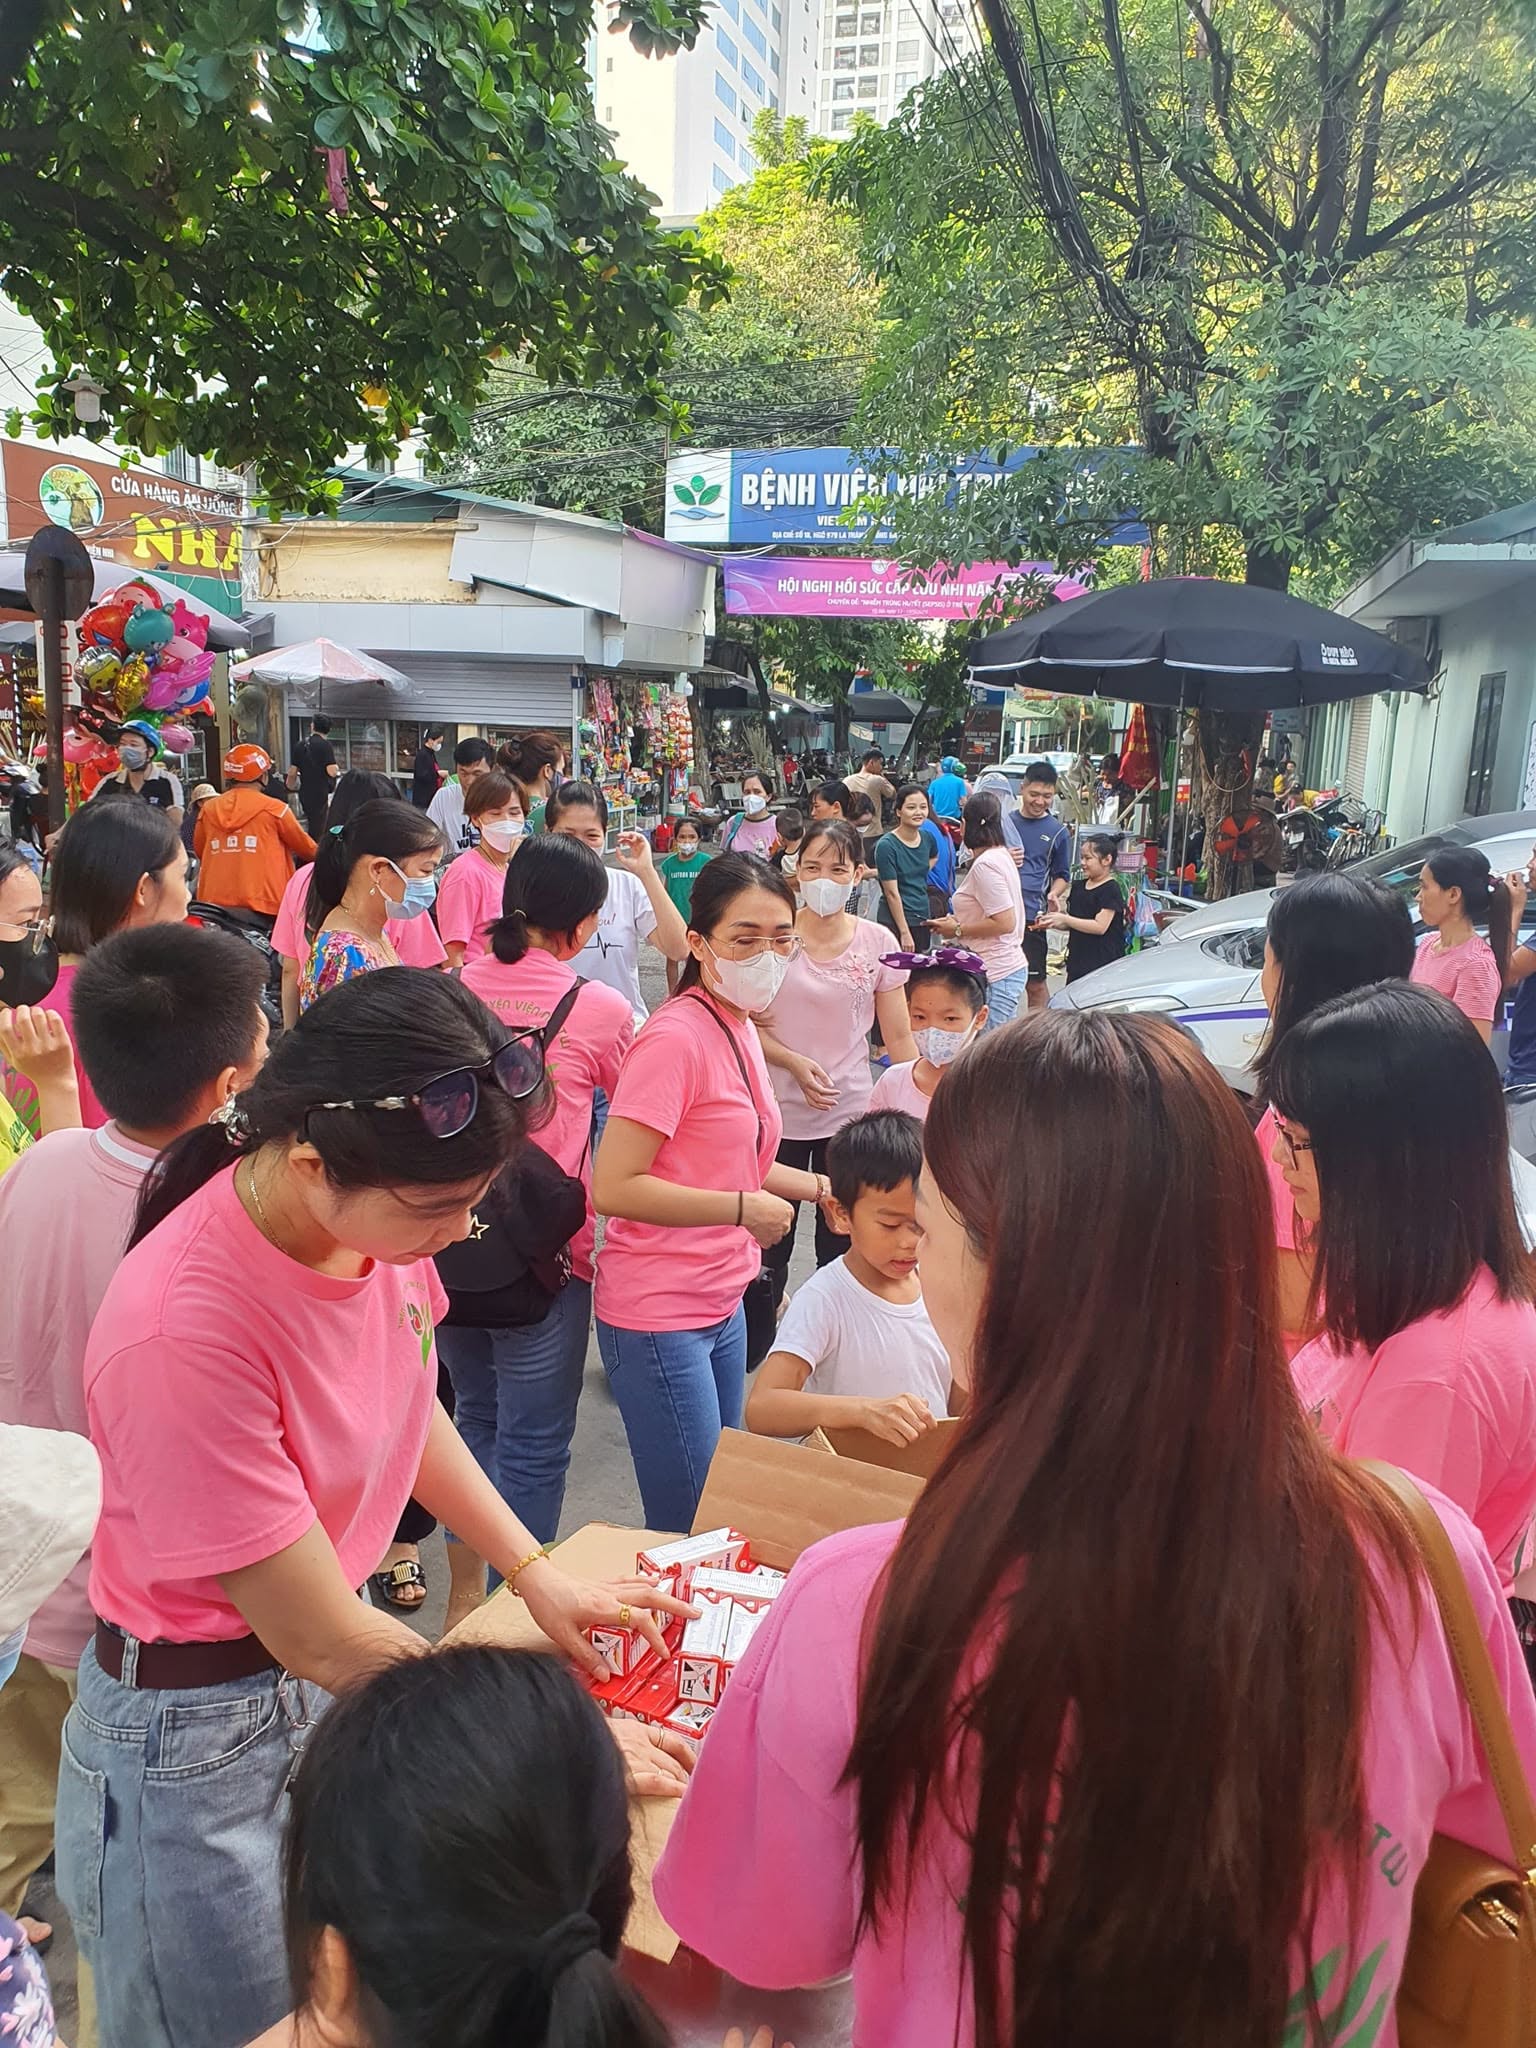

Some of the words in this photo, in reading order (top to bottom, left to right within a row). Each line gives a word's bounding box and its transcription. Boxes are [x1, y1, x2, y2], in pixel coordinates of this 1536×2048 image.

[111, 472, 142, 497] CỬA
[143, 481, 181, 506] HÀNG
[741, 467, 817, 511] BỆNH
[777, 576, 800, 596] HỘI
[801, 580, 833, 597] NGHỊ
[859, 576, 882, 595] SỨC
[940, 583, 964, 597] NHI
